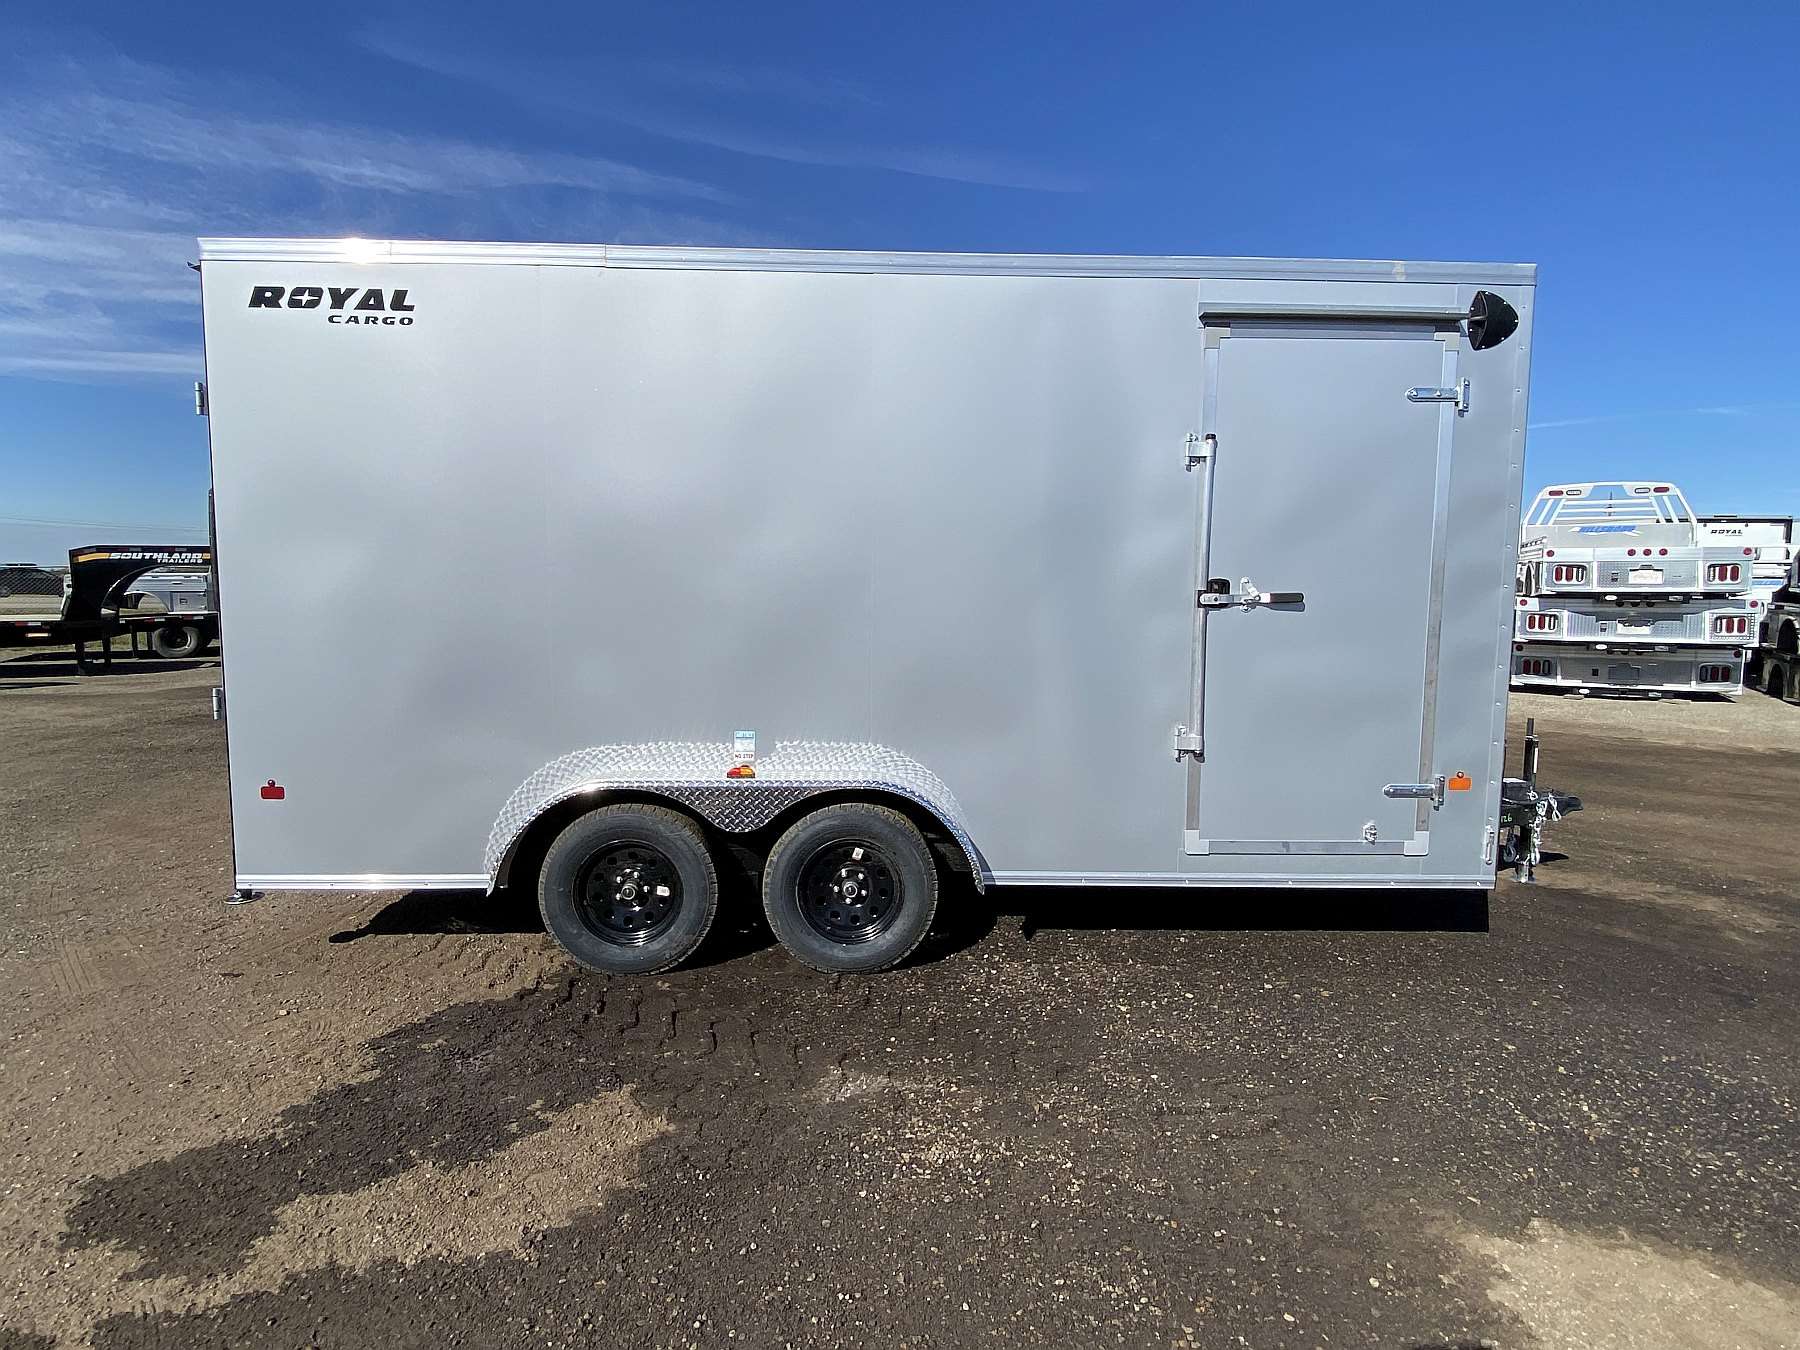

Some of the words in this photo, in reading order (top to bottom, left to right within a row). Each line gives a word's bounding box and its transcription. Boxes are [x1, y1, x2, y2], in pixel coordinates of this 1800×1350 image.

[248, 286, 415, 311] ROYAL
[327, 314, 414, 326] CARGO
[109, 552, 203, 560] SOUTHLAND
